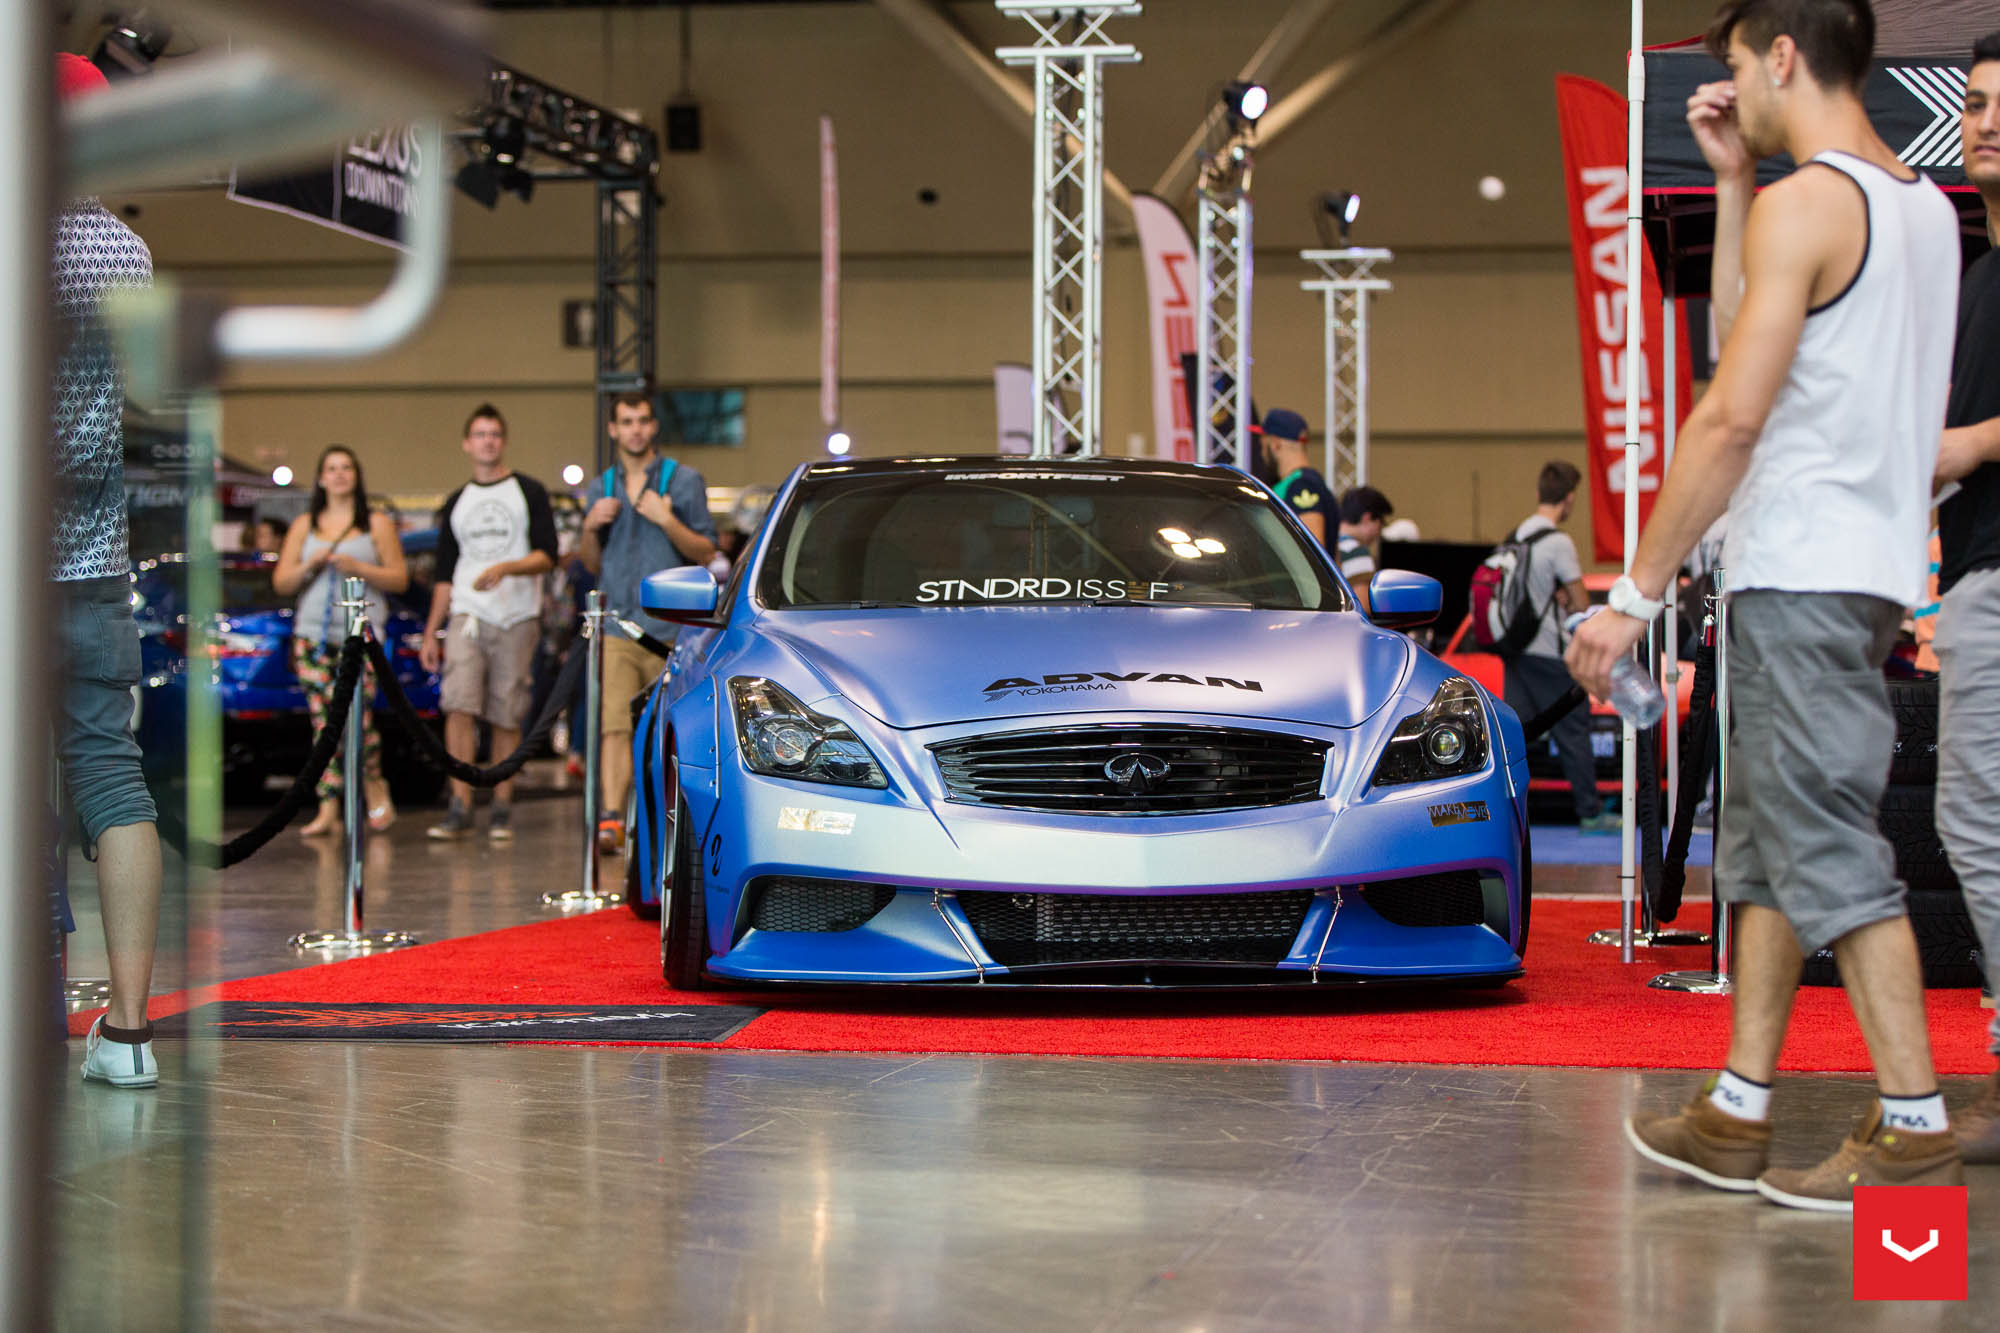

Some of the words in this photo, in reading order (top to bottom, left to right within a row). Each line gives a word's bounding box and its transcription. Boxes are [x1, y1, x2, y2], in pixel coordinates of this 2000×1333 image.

[1581, 166, 1659, 493] NISSAN
[915, 578, 1071, 602] STNDRD
[981, 671, 1264, 693] ADVAN
[1016, 682, 1117, 697] YOKOHAMA
